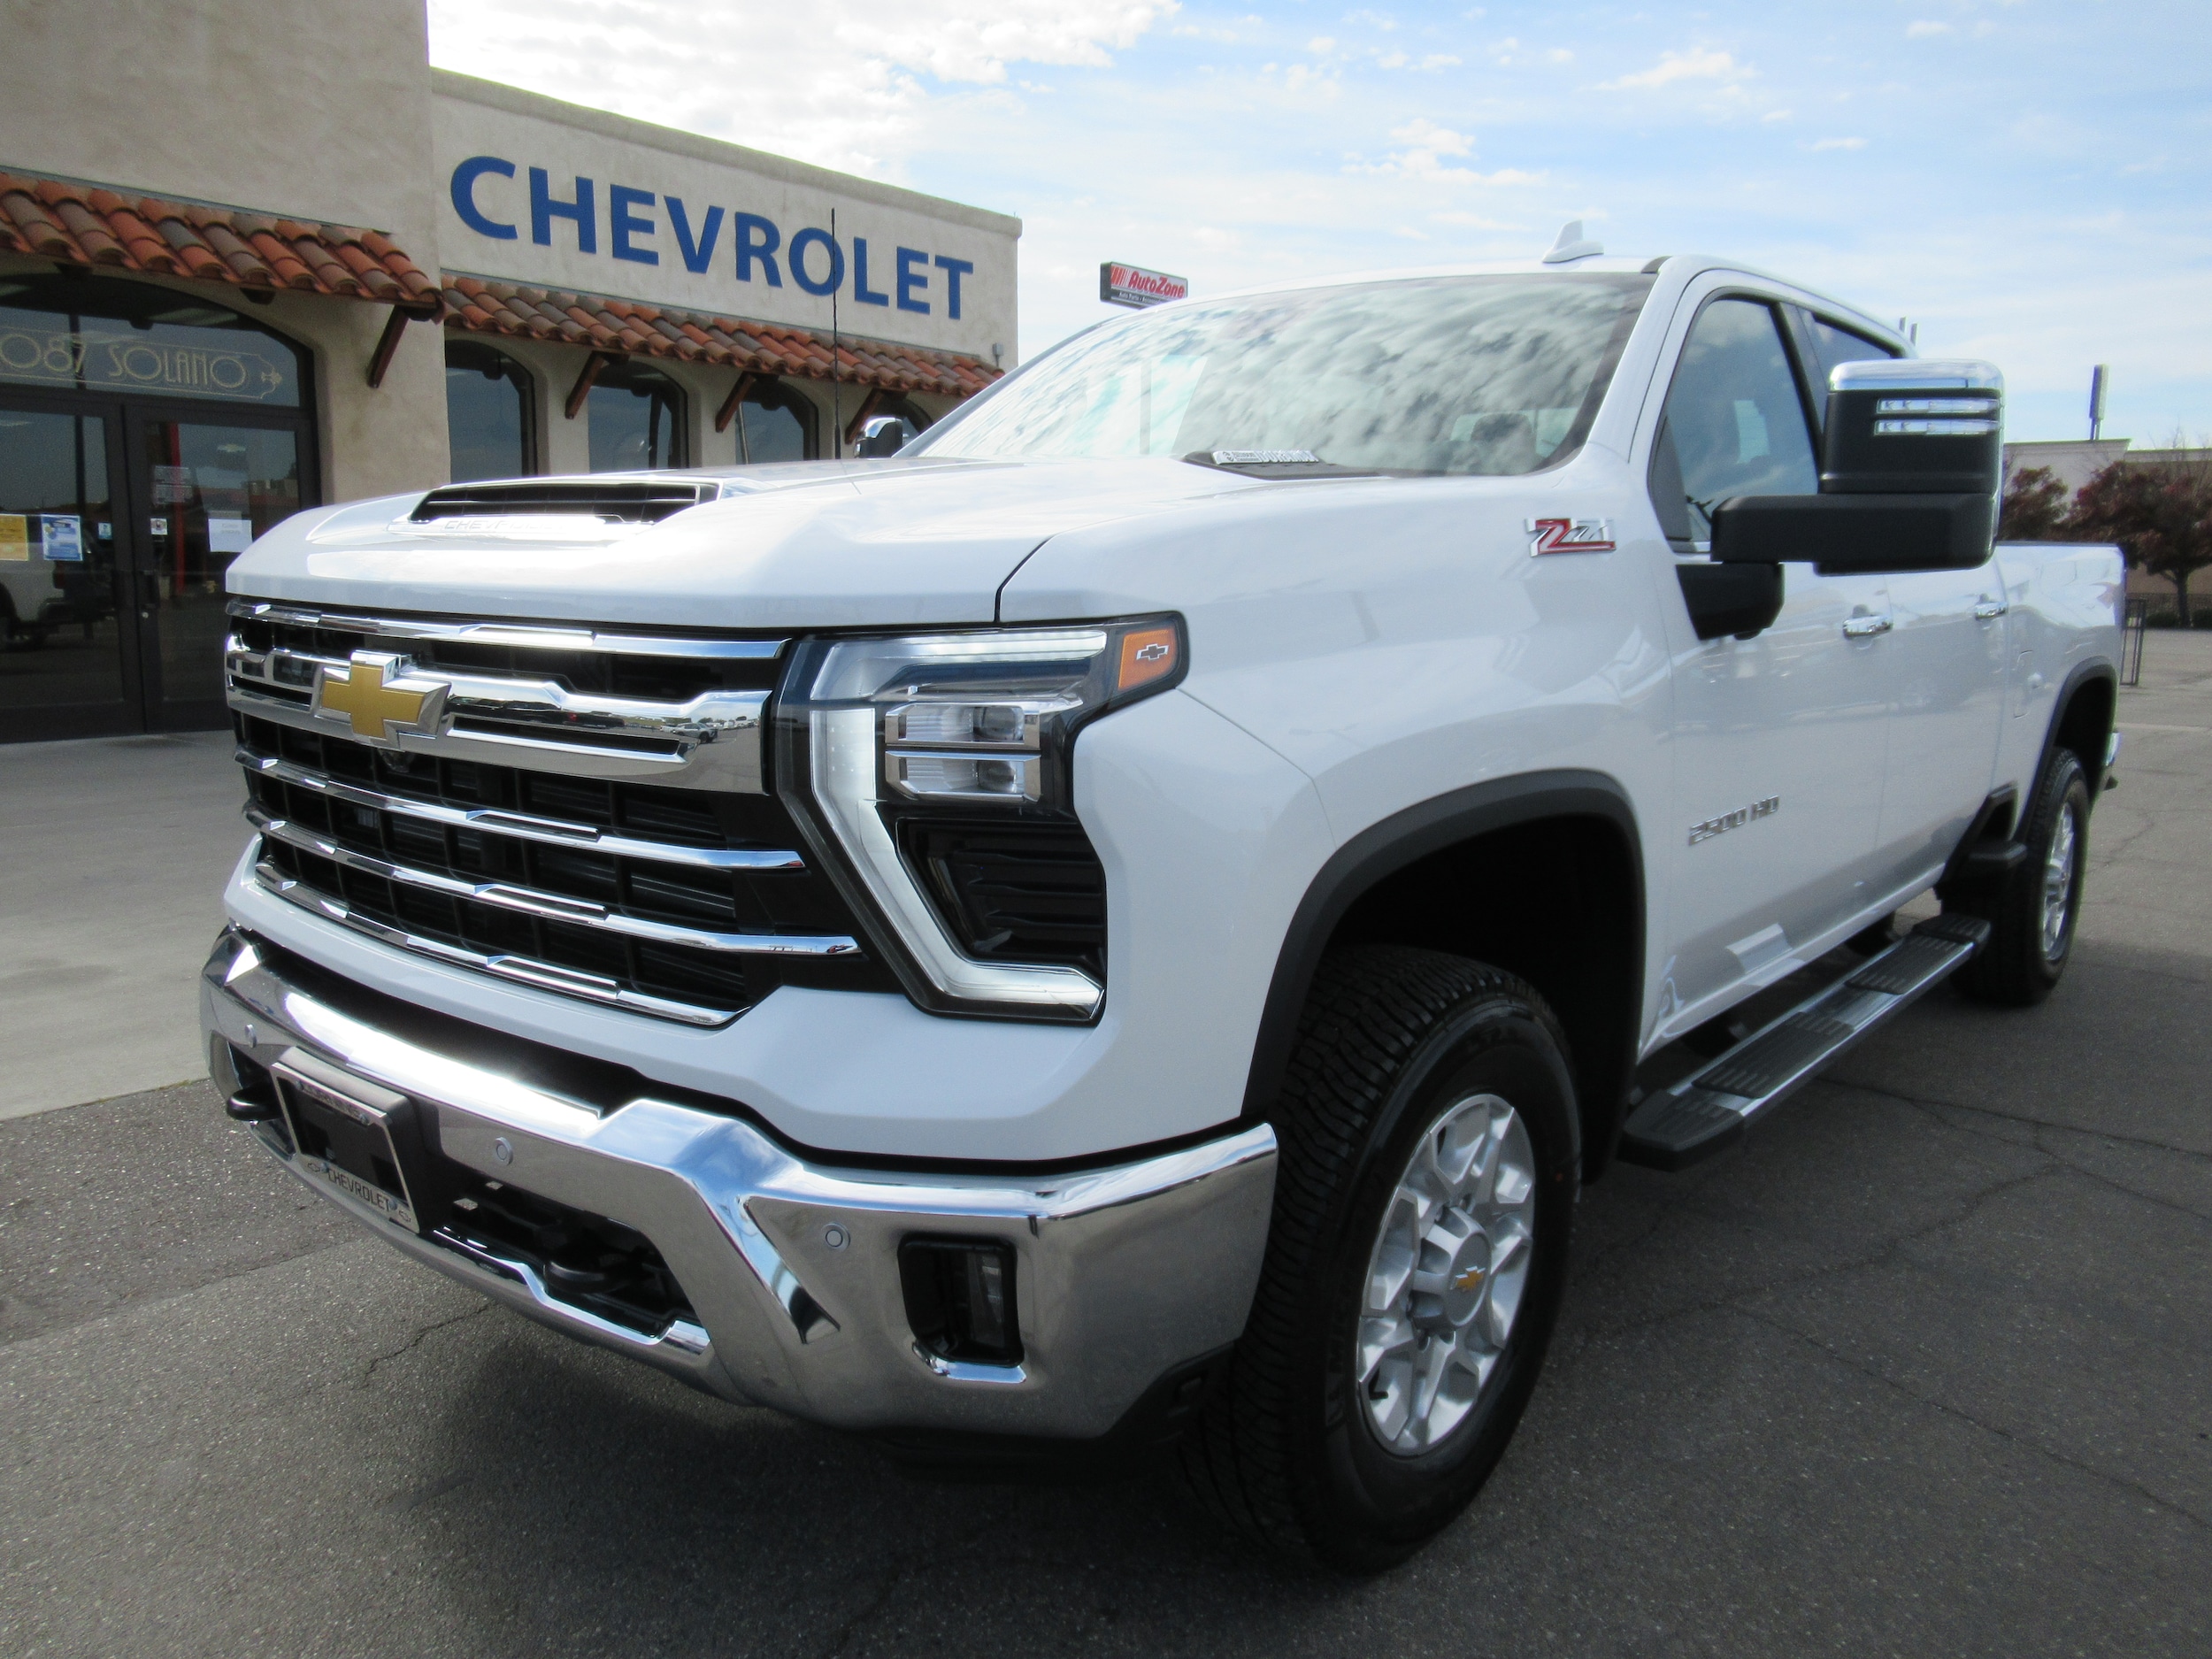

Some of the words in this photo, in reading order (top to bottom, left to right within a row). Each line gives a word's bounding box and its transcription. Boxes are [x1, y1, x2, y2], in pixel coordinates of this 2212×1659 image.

[450, 156, 973, 319] CHEVROLET
[1128, 271, 1185, 298] AutoZone
[108, 344, 247, 388] SOLANO
[1524, 518, 1617, 557] Z71
[1688, 806, 1747, 846] 2500
[1751, 795, 1779, 821] HD
[326, 1167, 390, 1212] CHEVROLET
